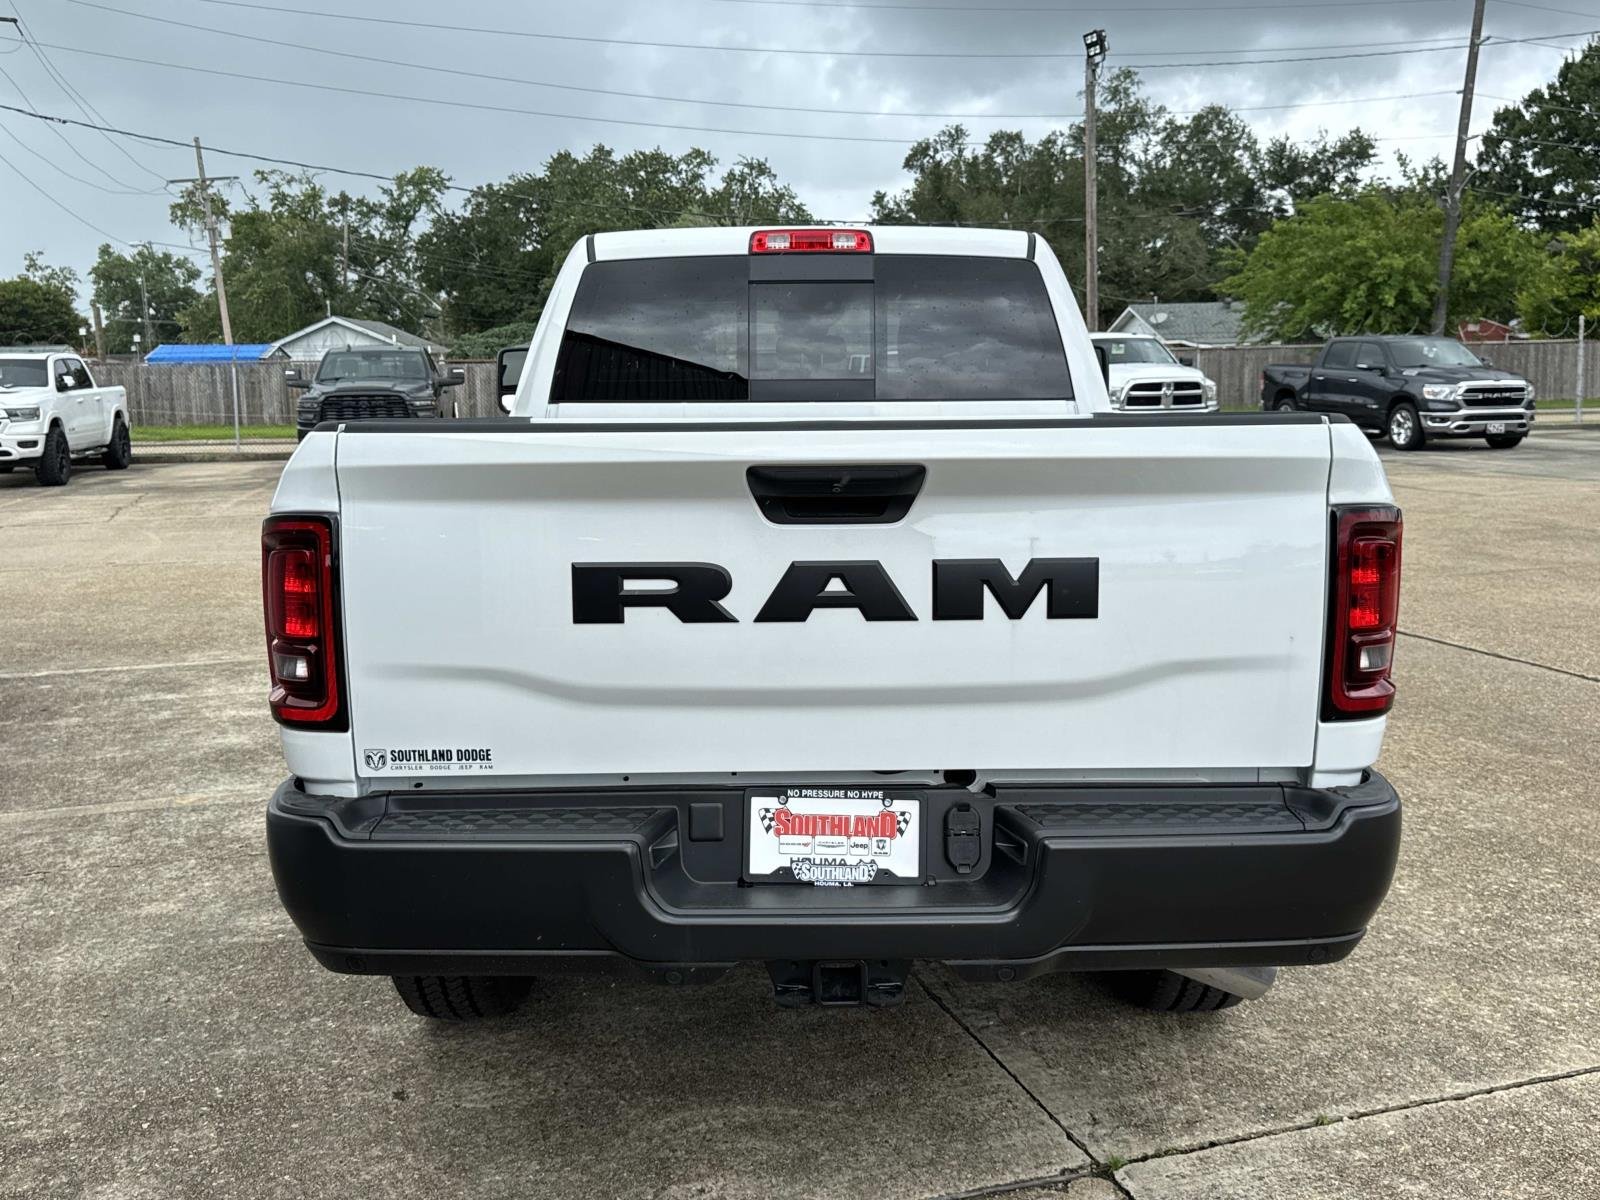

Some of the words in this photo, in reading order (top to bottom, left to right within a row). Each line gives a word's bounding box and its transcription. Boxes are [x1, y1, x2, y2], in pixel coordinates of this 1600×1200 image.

[571, 557, 1099, 624] RAM
[390, 749, 453, 762] SOUTHLAND
[456, 749, 492, 762] DODGE
[787, 789, 799, 797] NO
[802, 790, 845, 798] PRESSURE
[848, 790, 860, 798] NO
[862, 791, 884, 799] HYPE
[774, 809, 897, 840] SOUTHLAND
[850, 841, 868, 849] Jeep
[801, 863, 869, 882] SOUTHLAND
